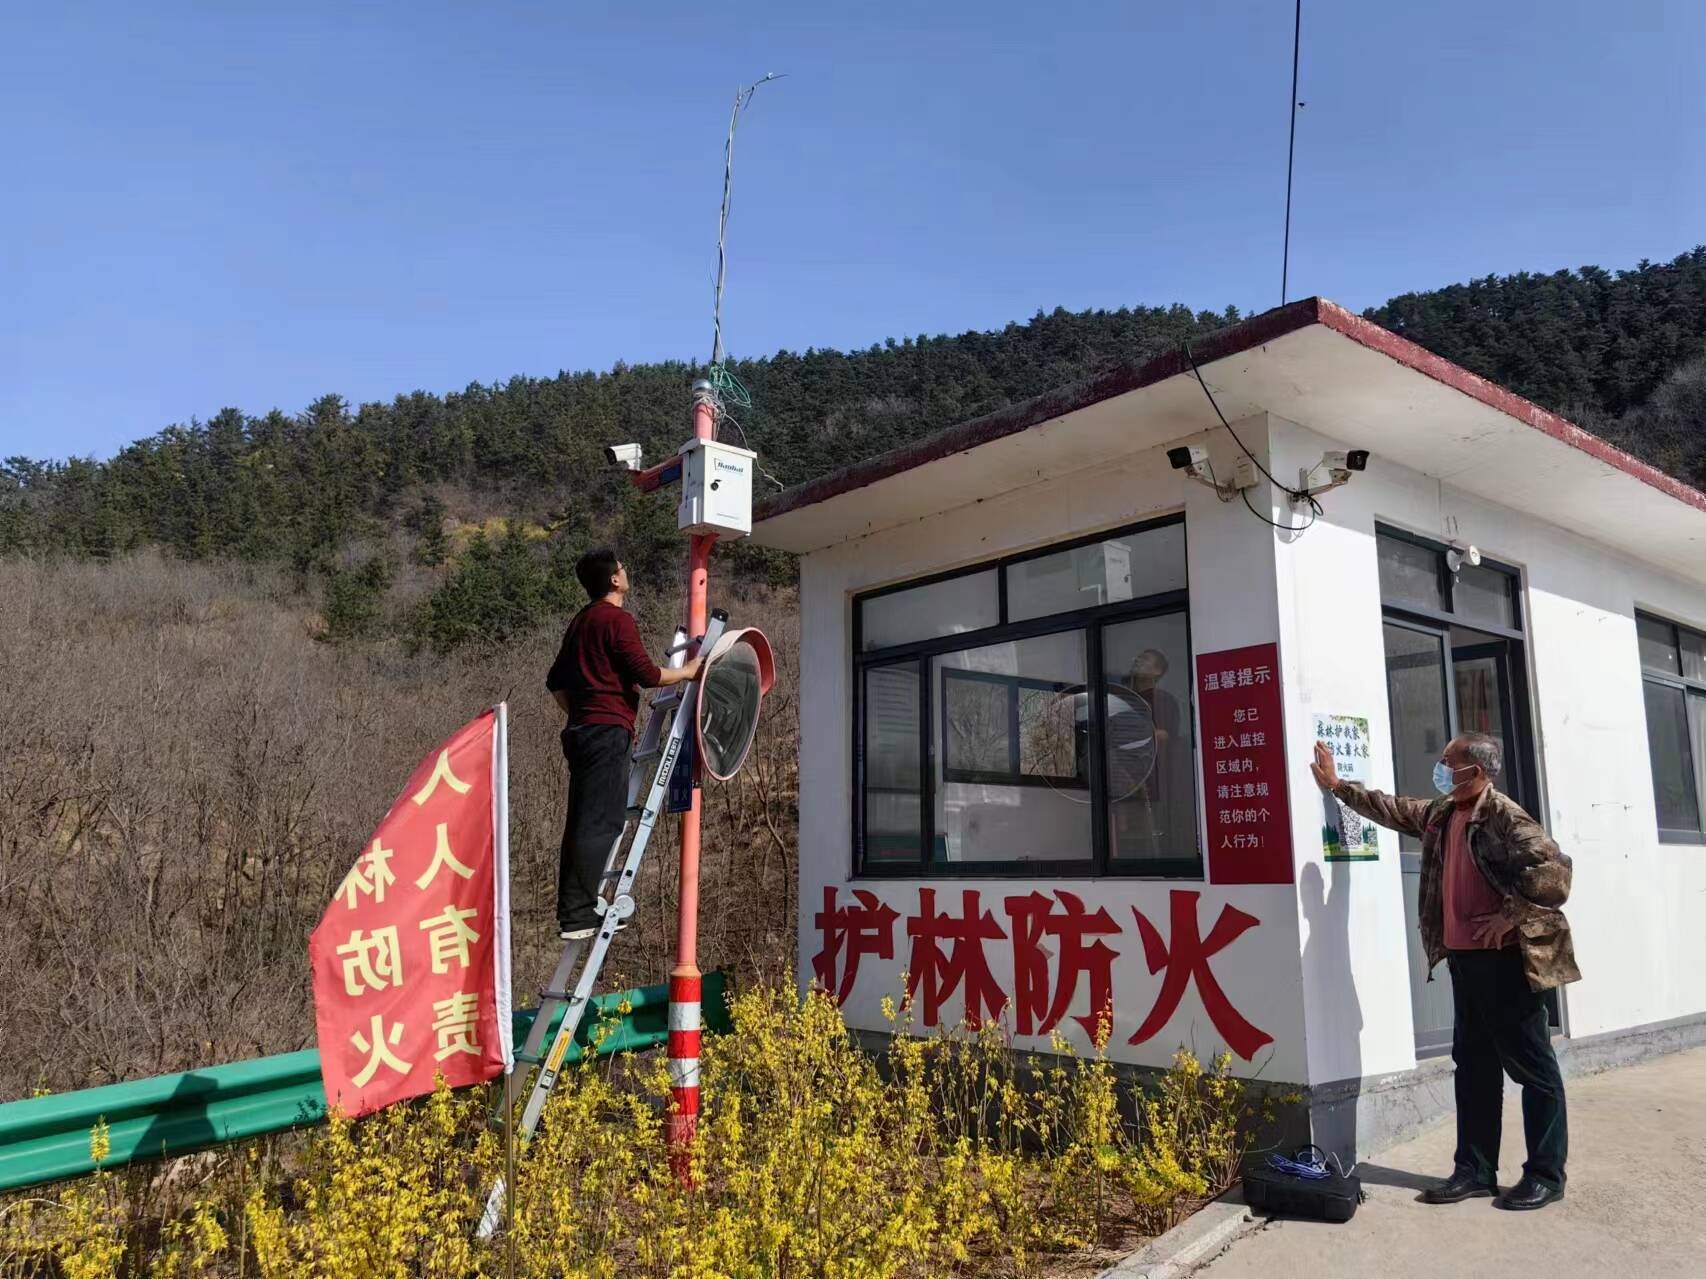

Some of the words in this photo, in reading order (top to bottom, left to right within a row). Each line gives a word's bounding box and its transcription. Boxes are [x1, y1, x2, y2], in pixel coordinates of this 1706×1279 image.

[1204, 665, 1271, 691] 温馨提示
[1233, 708, 1259, 723] 您已
[1213, 731, 1266, 750] 进入监控
[1217, 782, 1269, 799] 请注意规
[1219, 807, 1271, 824] 范你的个
[811, 886, 1276, 1062] 护林防火
